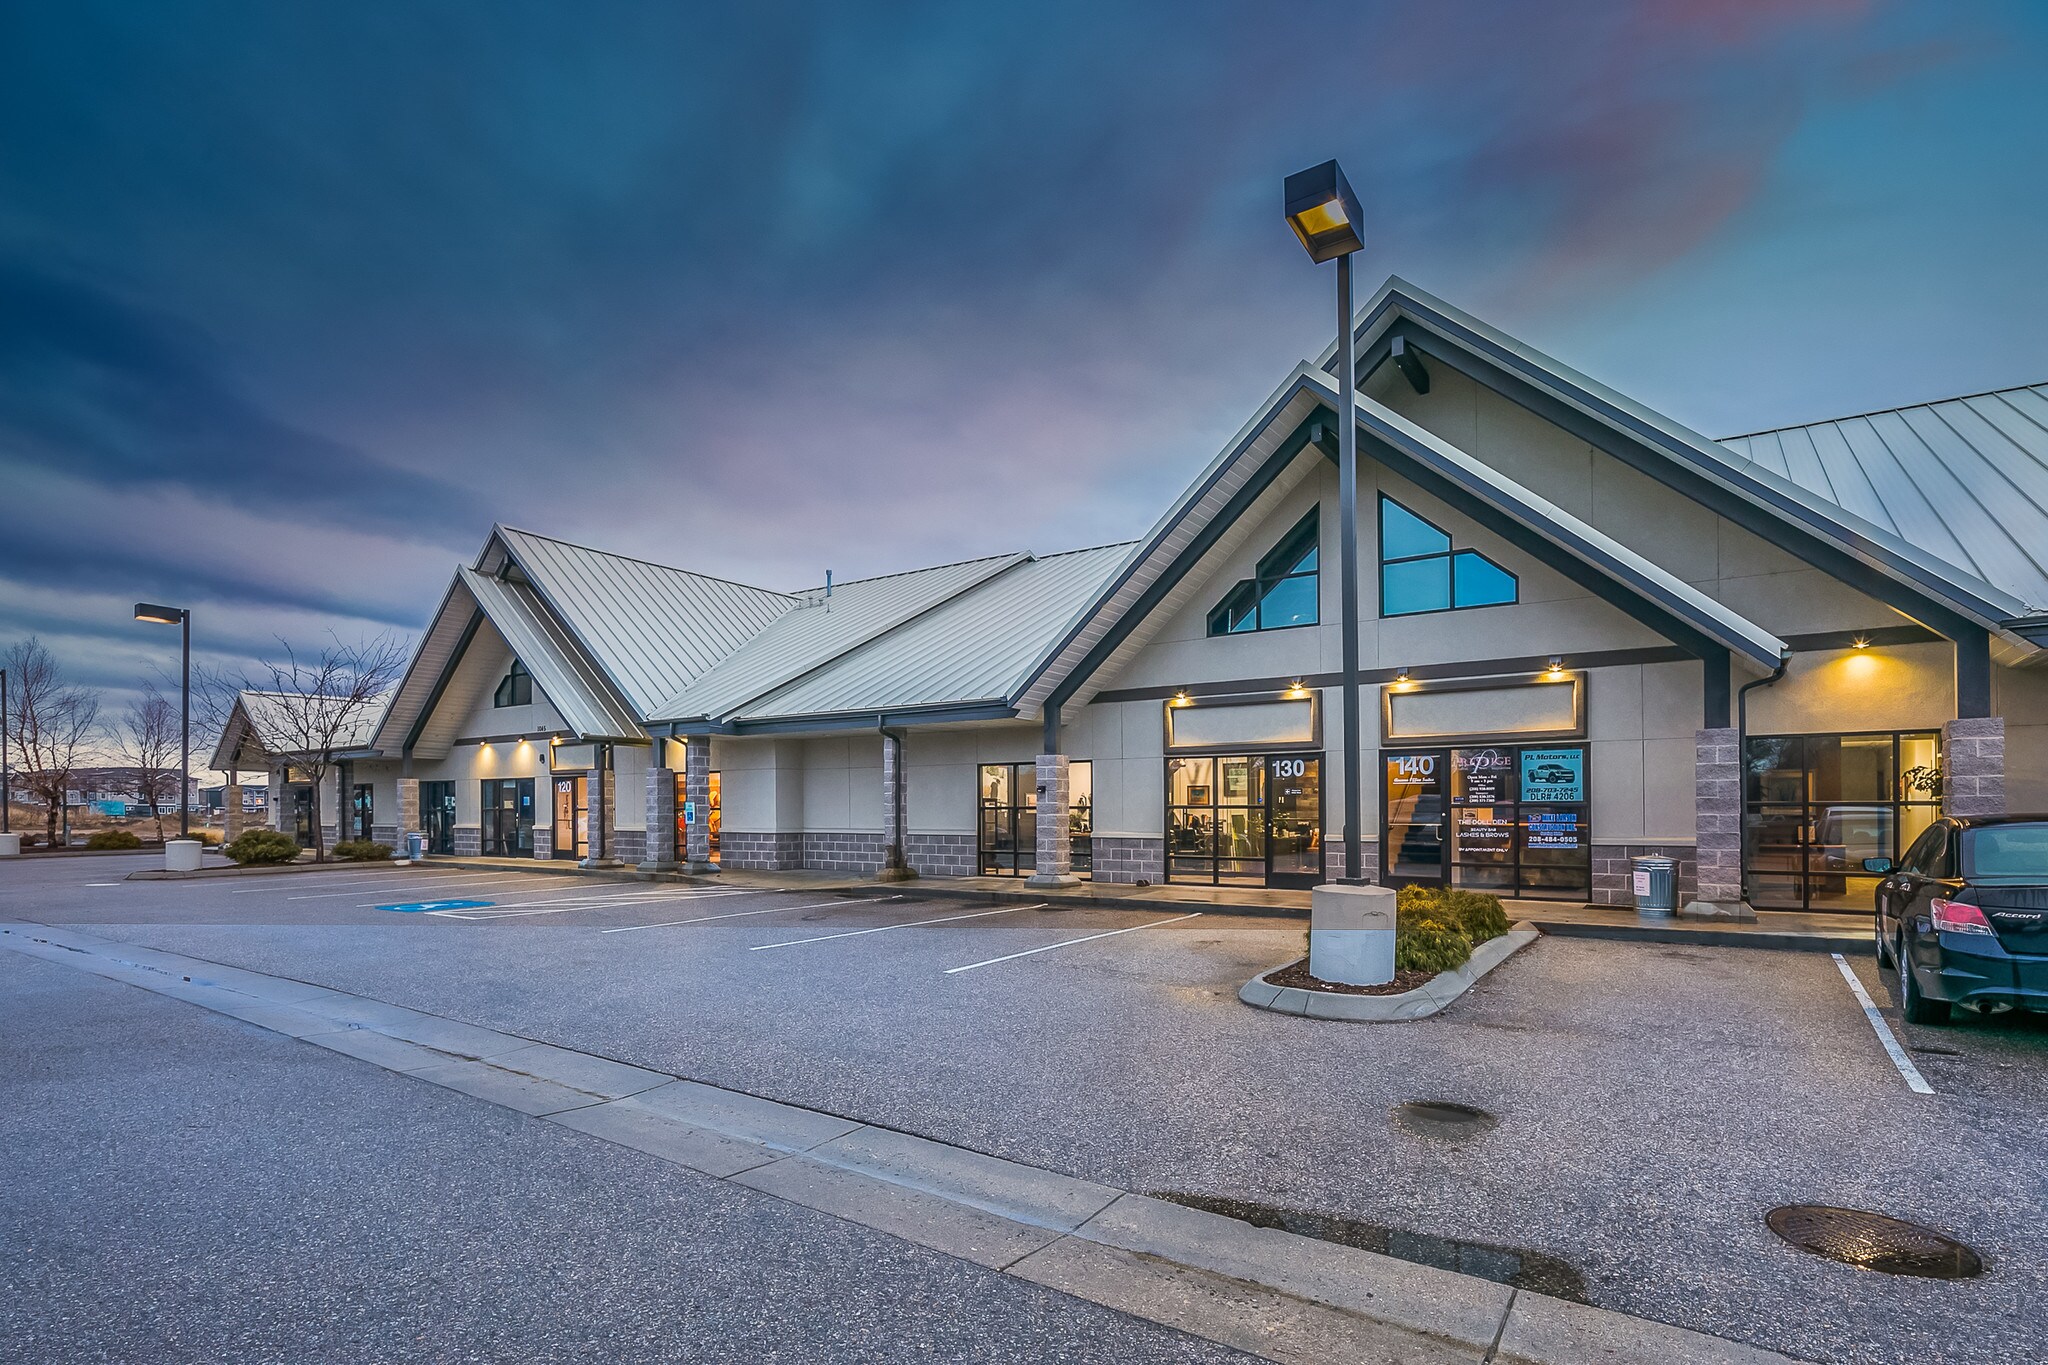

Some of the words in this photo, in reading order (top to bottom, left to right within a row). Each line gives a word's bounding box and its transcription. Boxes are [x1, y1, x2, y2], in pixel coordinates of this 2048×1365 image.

[1272, 760, 1304, 777] 130
[1395, 756, 1434, 775] 140
[558, 781, 572, 792] 120
